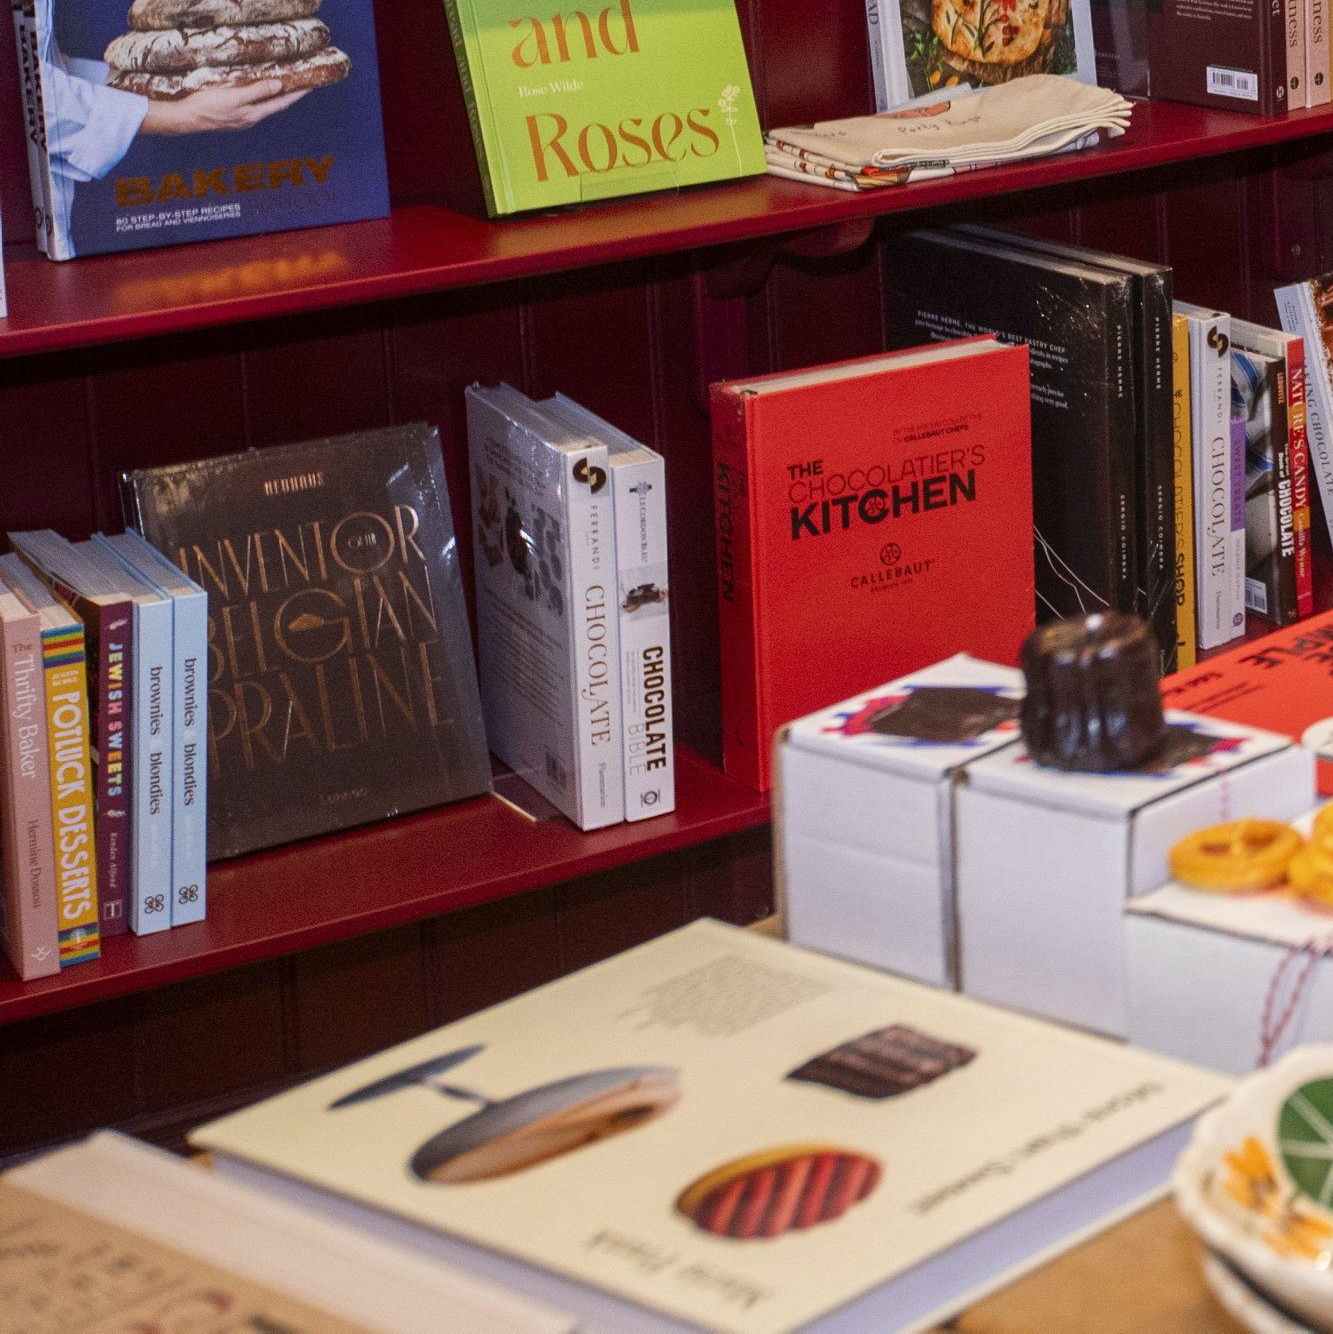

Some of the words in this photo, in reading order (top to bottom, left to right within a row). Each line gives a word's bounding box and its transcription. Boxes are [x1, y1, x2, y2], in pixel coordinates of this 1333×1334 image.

[519, 82, 548, 99] Rose
[551, 77, 584, 96] Wilde
[524, 103, 721, 184] Roses
[114, 154, 336, 208] BAKERY
[1288, 368, 1304, 450] NATURE'S
[264, 471, 325, 497] NEUHAUS
[787, 445, 985, 500] CHOCOLATIER'S
[788, 459, 824, 480] THE
[1293, 452, 1306, 508] CANDY
[590, 505, 600, 571] FERRANDI
[790, 470, 977, 541] KITCHEN
[850, 560, 933, 591] CALLEBAUT
[13, 643, 33, 652] The
[108, 642, 123, 715] JEWISH
[581, 584, 611, 746] CHOCOLATE
[13, 654, 36, 721] Thrifty
[206, 640, 455, 768] PRALINE
[642, 646, 667, 771] CHOCOLATE
[18, 726, 38, 778] Baker
[52, 692, 85, 799] POTLUCK
[107, 722, 123, 797] SWEETS
[58, 805, 91, 920] DESSERTS
